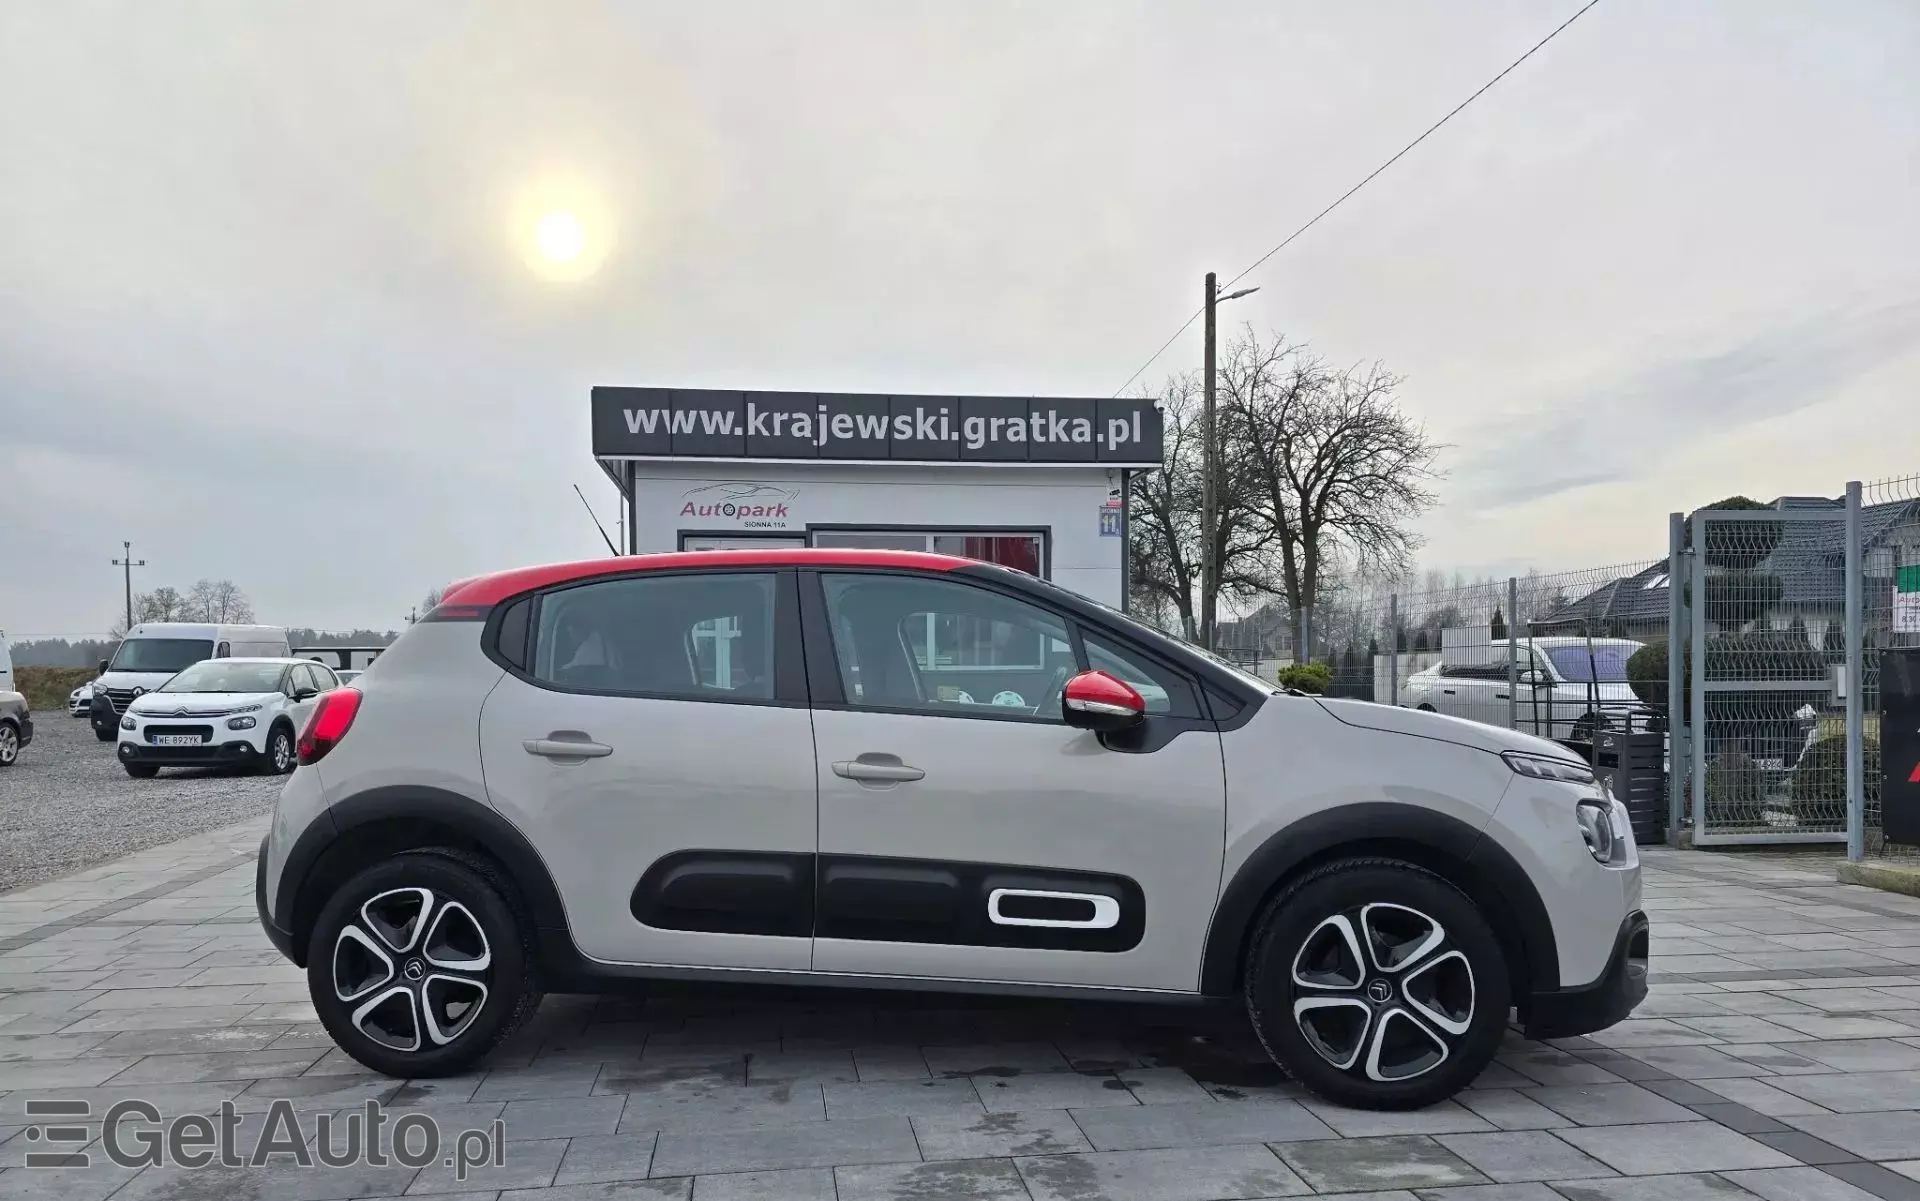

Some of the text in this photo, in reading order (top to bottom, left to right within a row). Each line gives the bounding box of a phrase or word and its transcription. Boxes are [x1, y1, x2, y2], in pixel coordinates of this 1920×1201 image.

[622, 402, 1143, 451] www.krajewski.gratka.pl
[158, 736, 199, 744] WE 892YK
